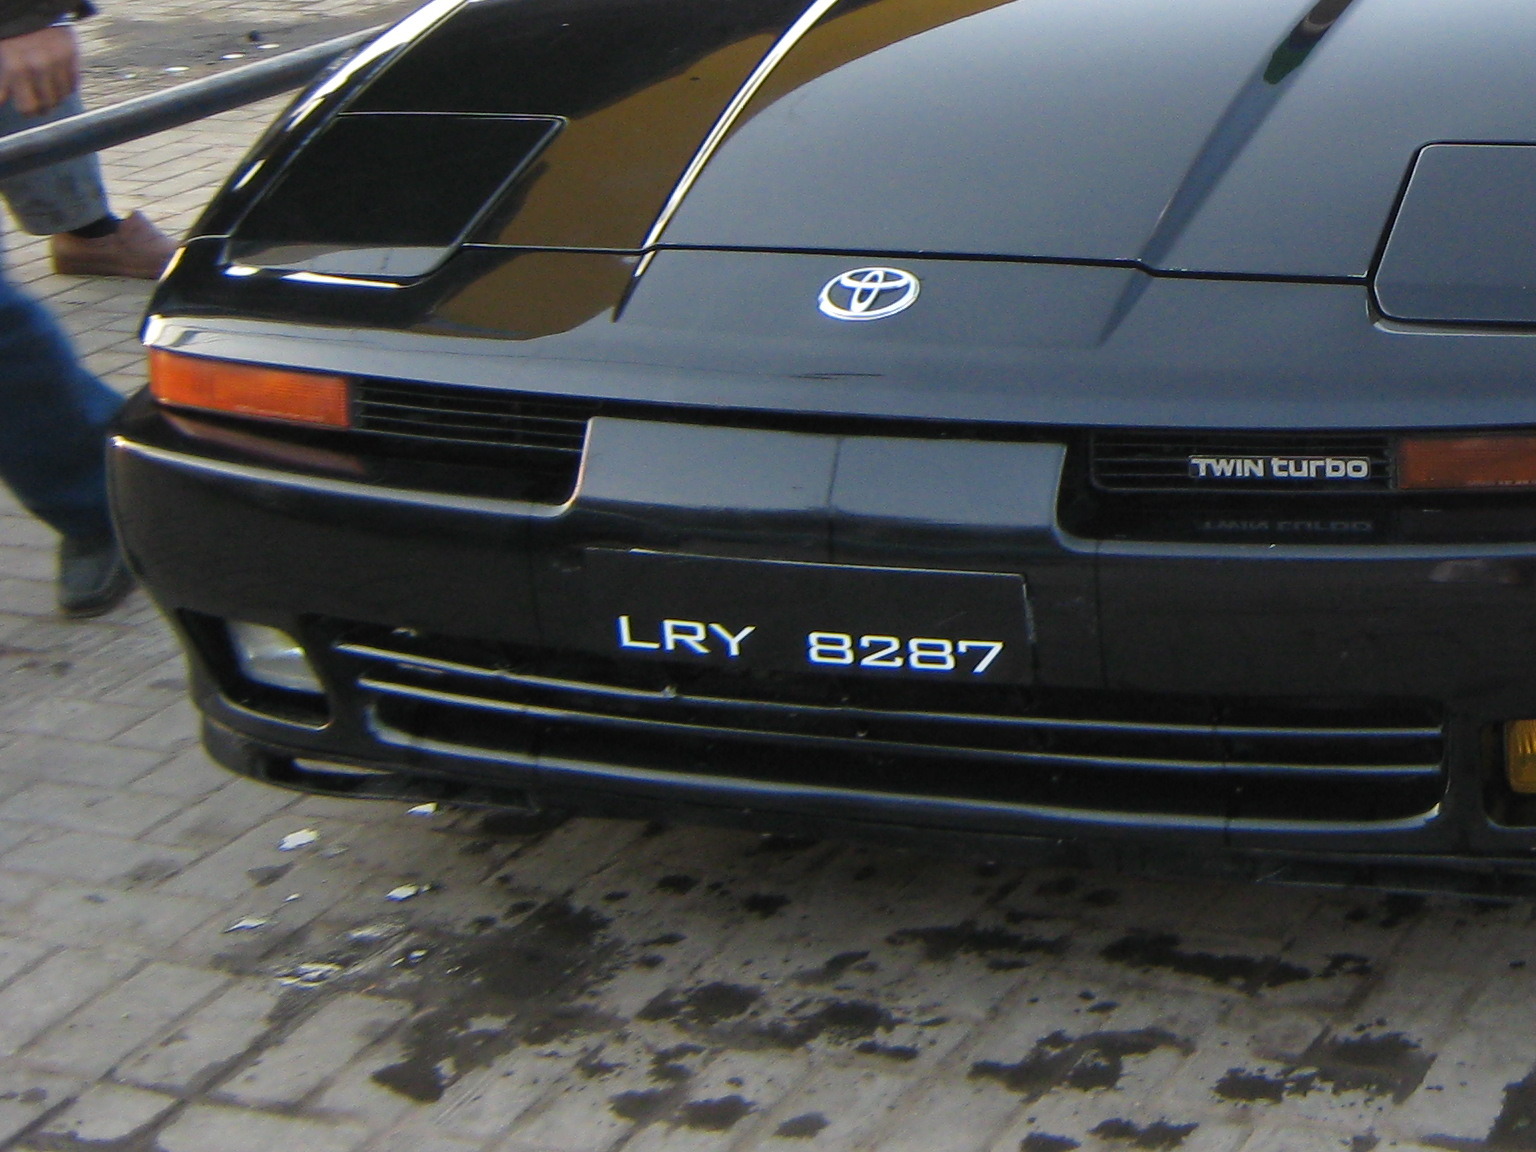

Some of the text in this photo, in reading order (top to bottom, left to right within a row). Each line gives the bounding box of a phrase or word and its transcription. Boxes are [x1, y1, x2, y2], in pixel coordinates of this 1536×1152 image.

[1191, 456, 1369, 478] TWIN turbo
[617, 614, 1005, 674] LRY 8287
